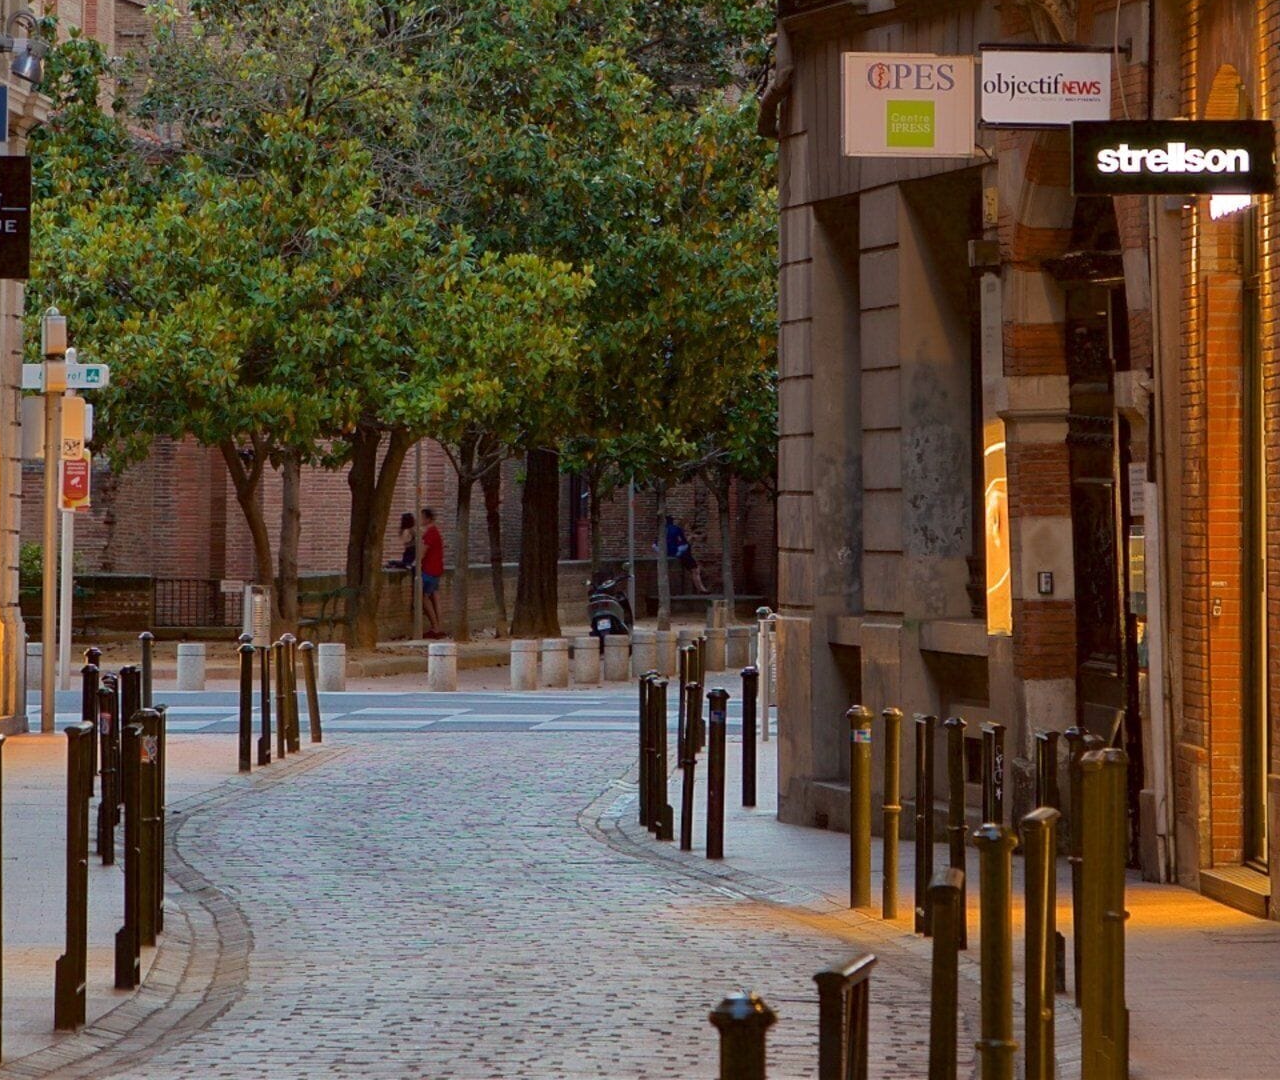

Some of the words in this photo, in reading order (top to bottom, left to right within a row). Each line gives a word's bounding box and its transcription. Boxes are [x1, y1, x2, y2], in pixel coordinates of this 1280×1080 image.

[866, 61, 956, 92] CPES
[891, 112, 931, 123] Centre
[1096, 141, 1251, 175] strellson
